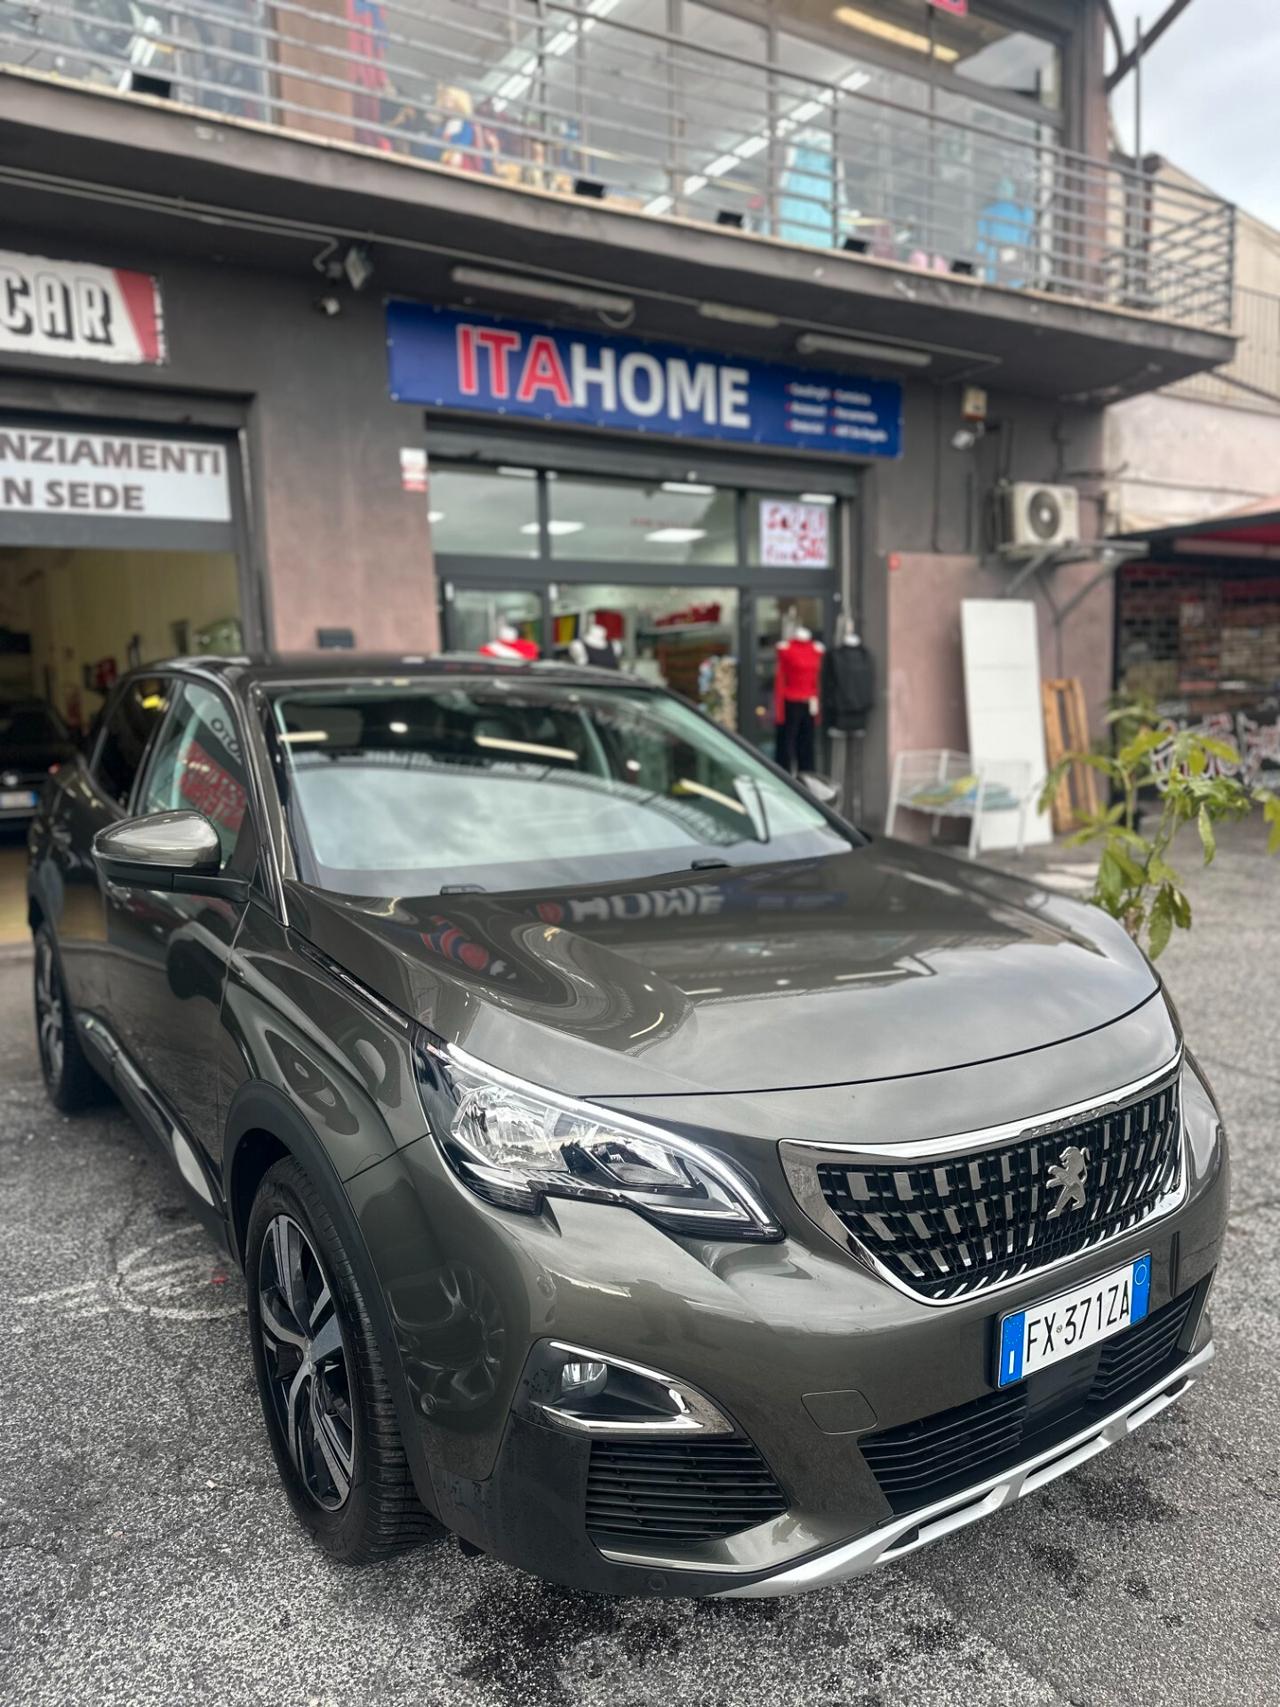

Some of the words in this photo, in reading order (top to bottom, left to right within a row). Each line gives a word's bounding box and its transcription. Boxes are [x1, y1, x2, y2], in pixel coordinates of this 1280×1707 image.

[0, 265, 114, 346] CAR
[456, 323, 750, 429] ITAHOME
[0, 433, 220, 476] NZIAMENTI
[45, 480, 145, 511] SEDE
